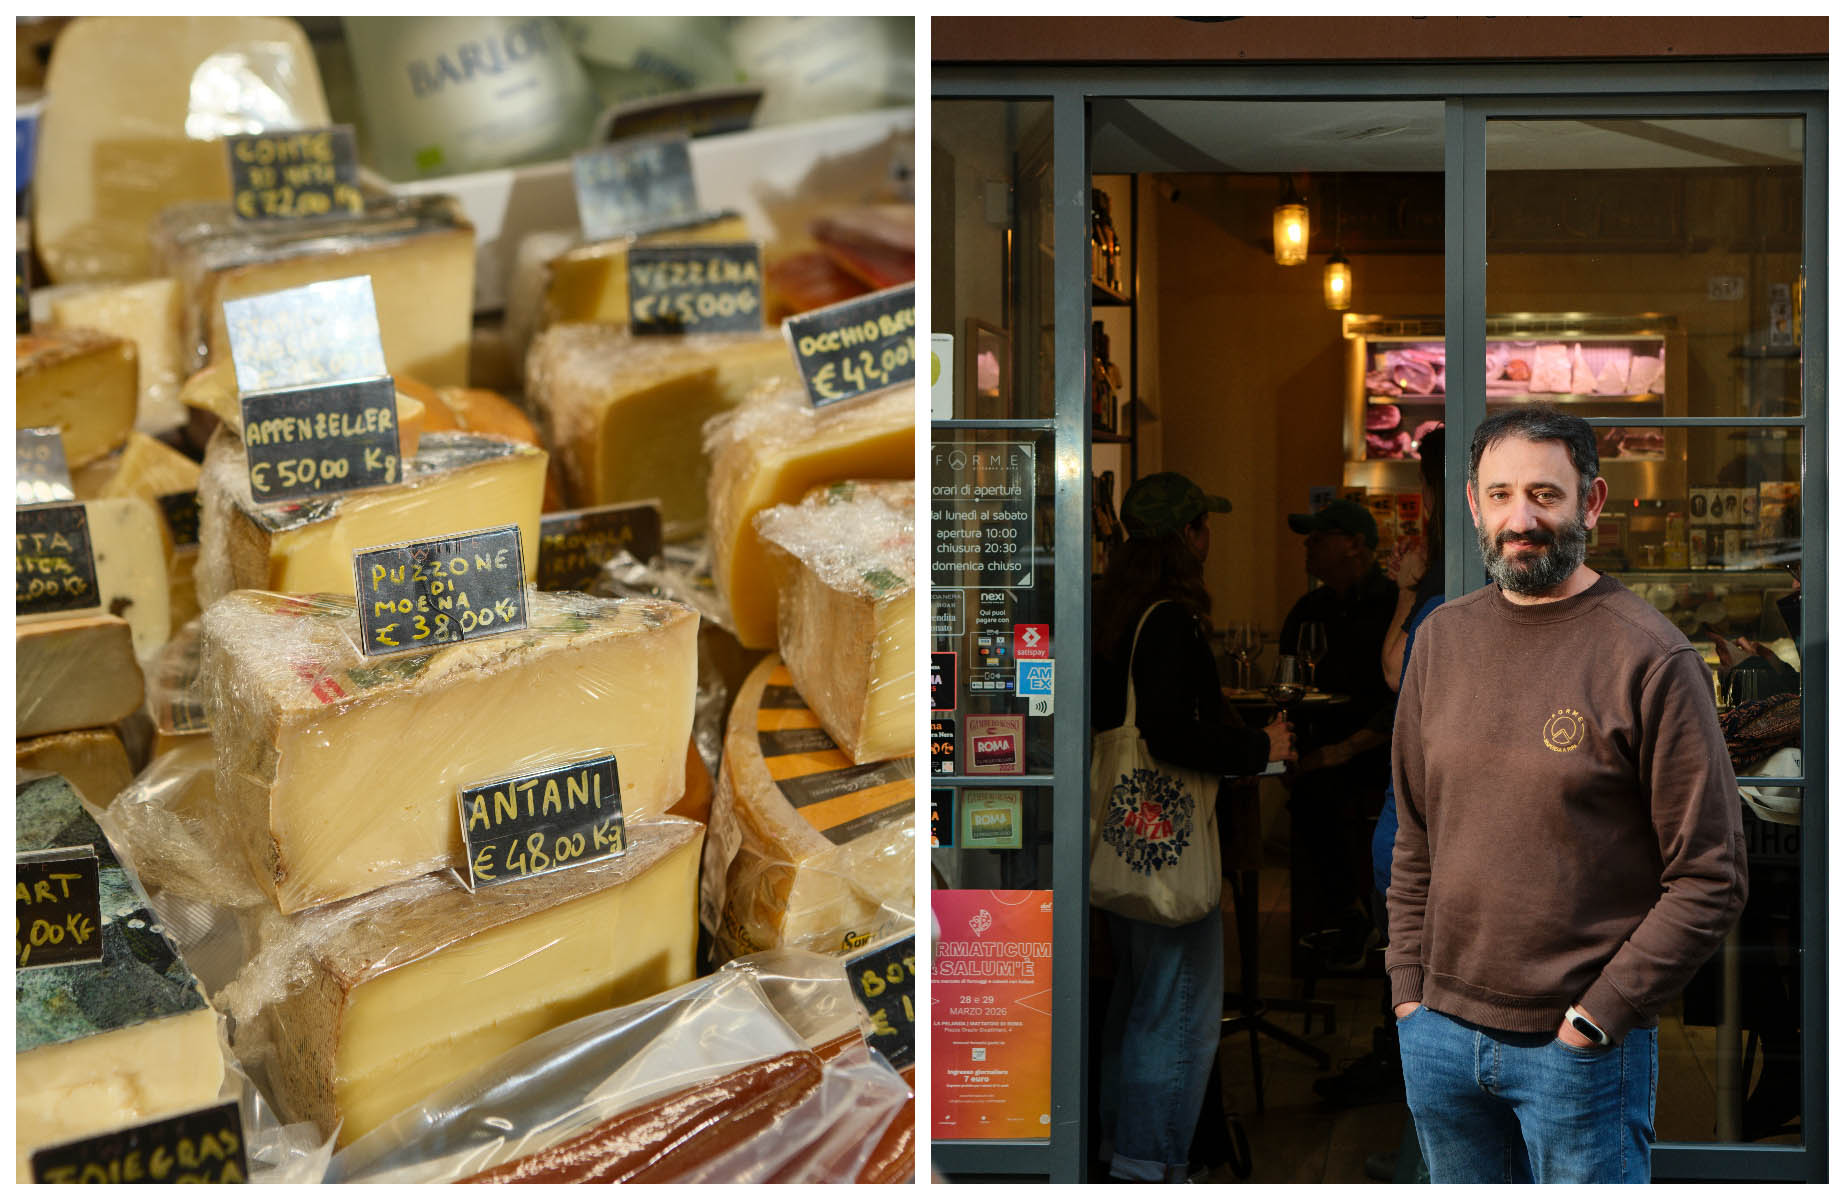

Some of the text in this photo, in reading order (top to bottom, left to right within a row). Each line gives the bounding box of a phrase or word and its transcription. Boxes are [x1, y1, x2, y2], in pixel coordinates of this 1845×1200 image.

[247, 408, 392, 446] APPENZELLER
[932, 484, 1022, 497] orari di apertura
[980, 510, 990, 520] al
[992, 510, 1028, 520] sabato
[936, 528, 1017, 540] apertura 10:00
[936, 542, 1017, 553] chiusura 20:30
[372, 549, 508, 591] PUZZONE
[932, 561, 1022, 571] domenica chiuso
[431, 579, 454, 595] DI
[981, 593, 1005, 601] nexi
[375, 592, 471, 617] MOENA
[1017, 649, 1046, 657] satispay
[978, 739, 1009, 752] ROMA
[469, 770, 601, 831] ANTANI
[473, 845, 496, 880] €
[506, 832, 585, 875] 48,00
[960, 996, 971, 1004] 28
[983, 996, 994, 1004] 29
[949, 1007, 1007, 1016] MARZO 2026
